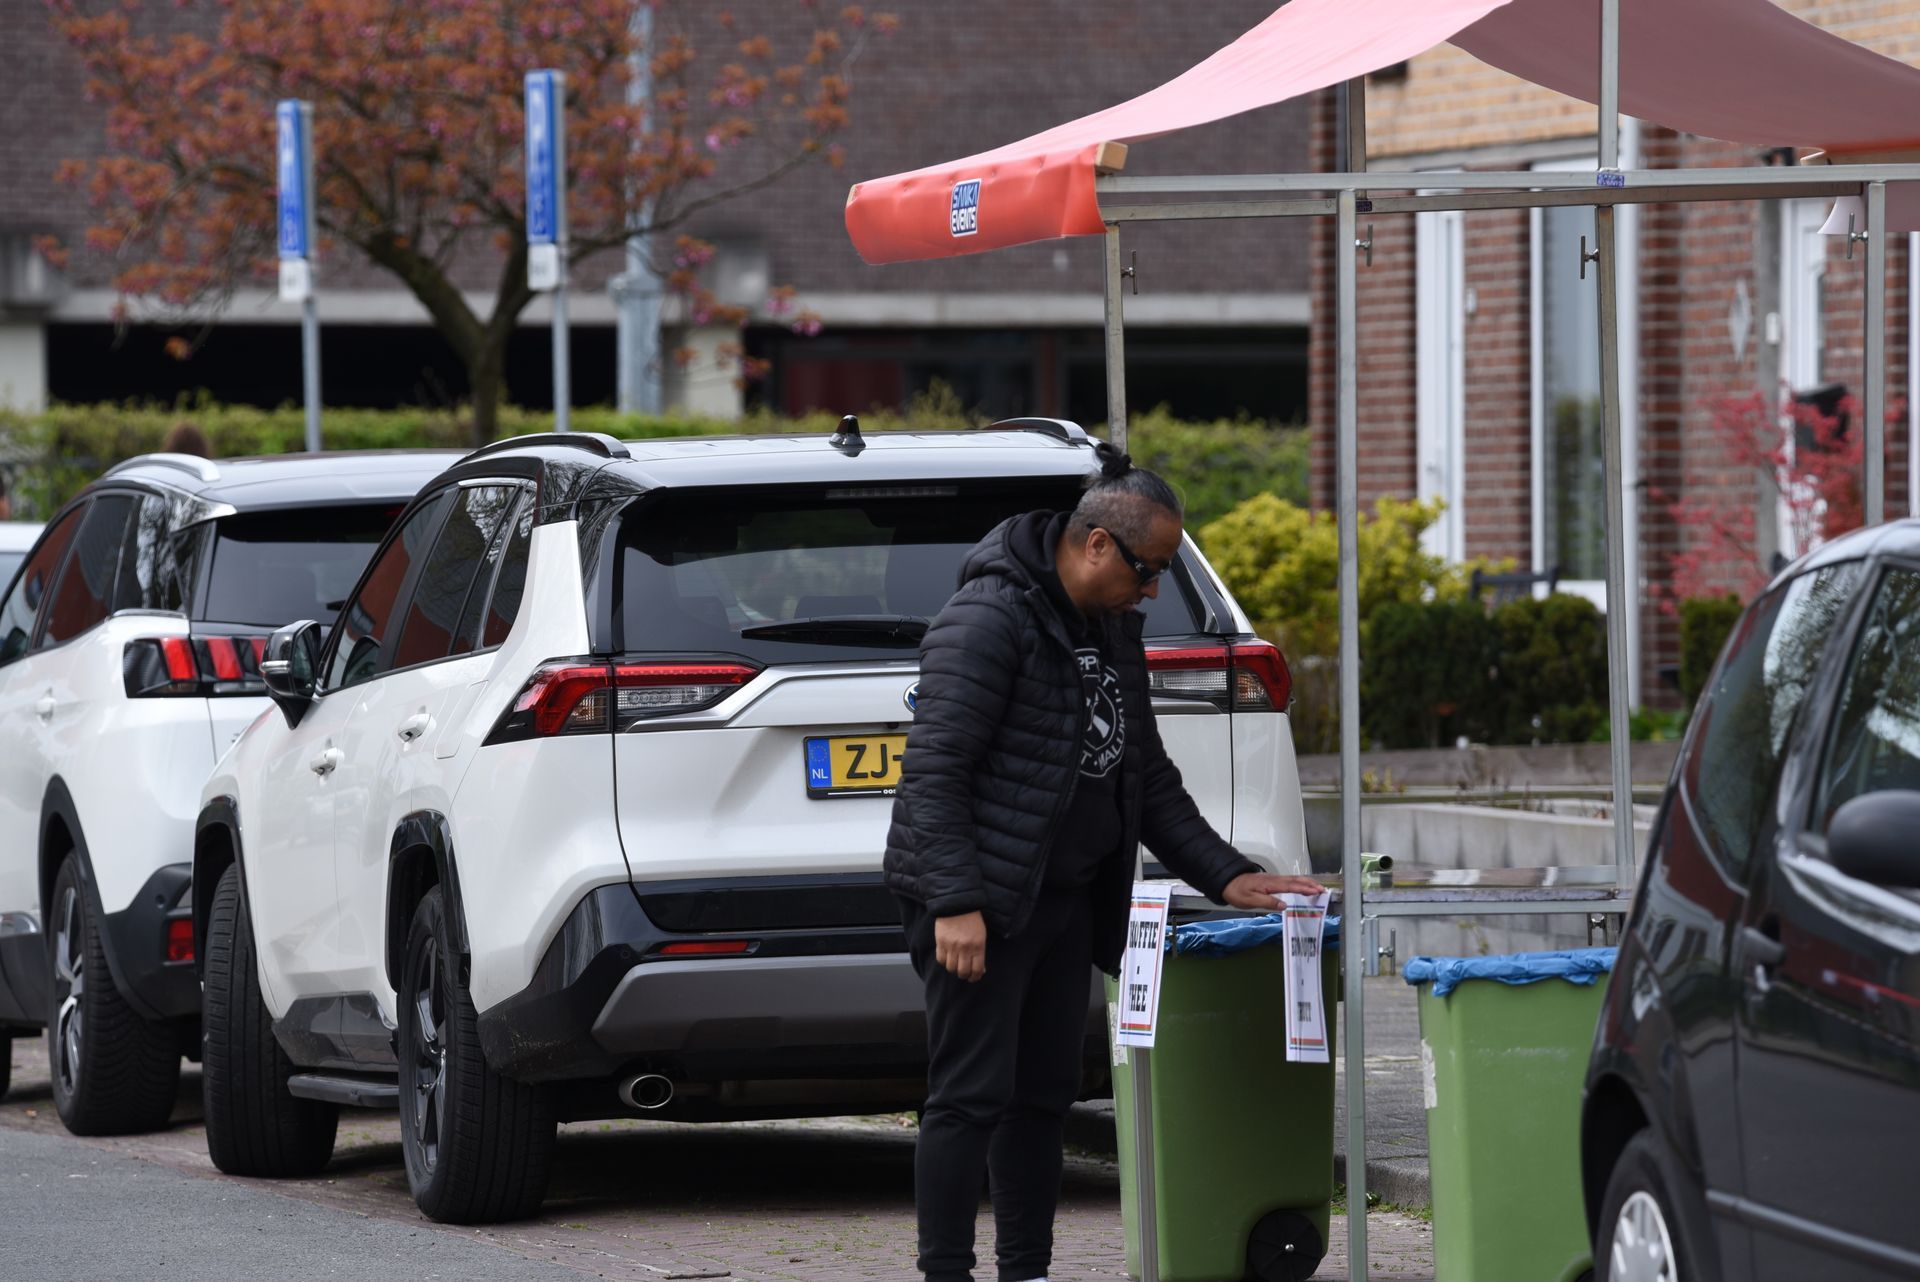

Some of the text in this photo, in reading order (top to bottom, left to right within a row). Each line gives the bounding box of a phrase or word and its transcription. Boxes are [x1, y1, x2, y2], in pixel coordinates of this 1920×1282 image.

[953, 183, 978, 208] SANKA
[952, 206, 976, 232] EVENTS
[812, 768, 829, 780] NL
